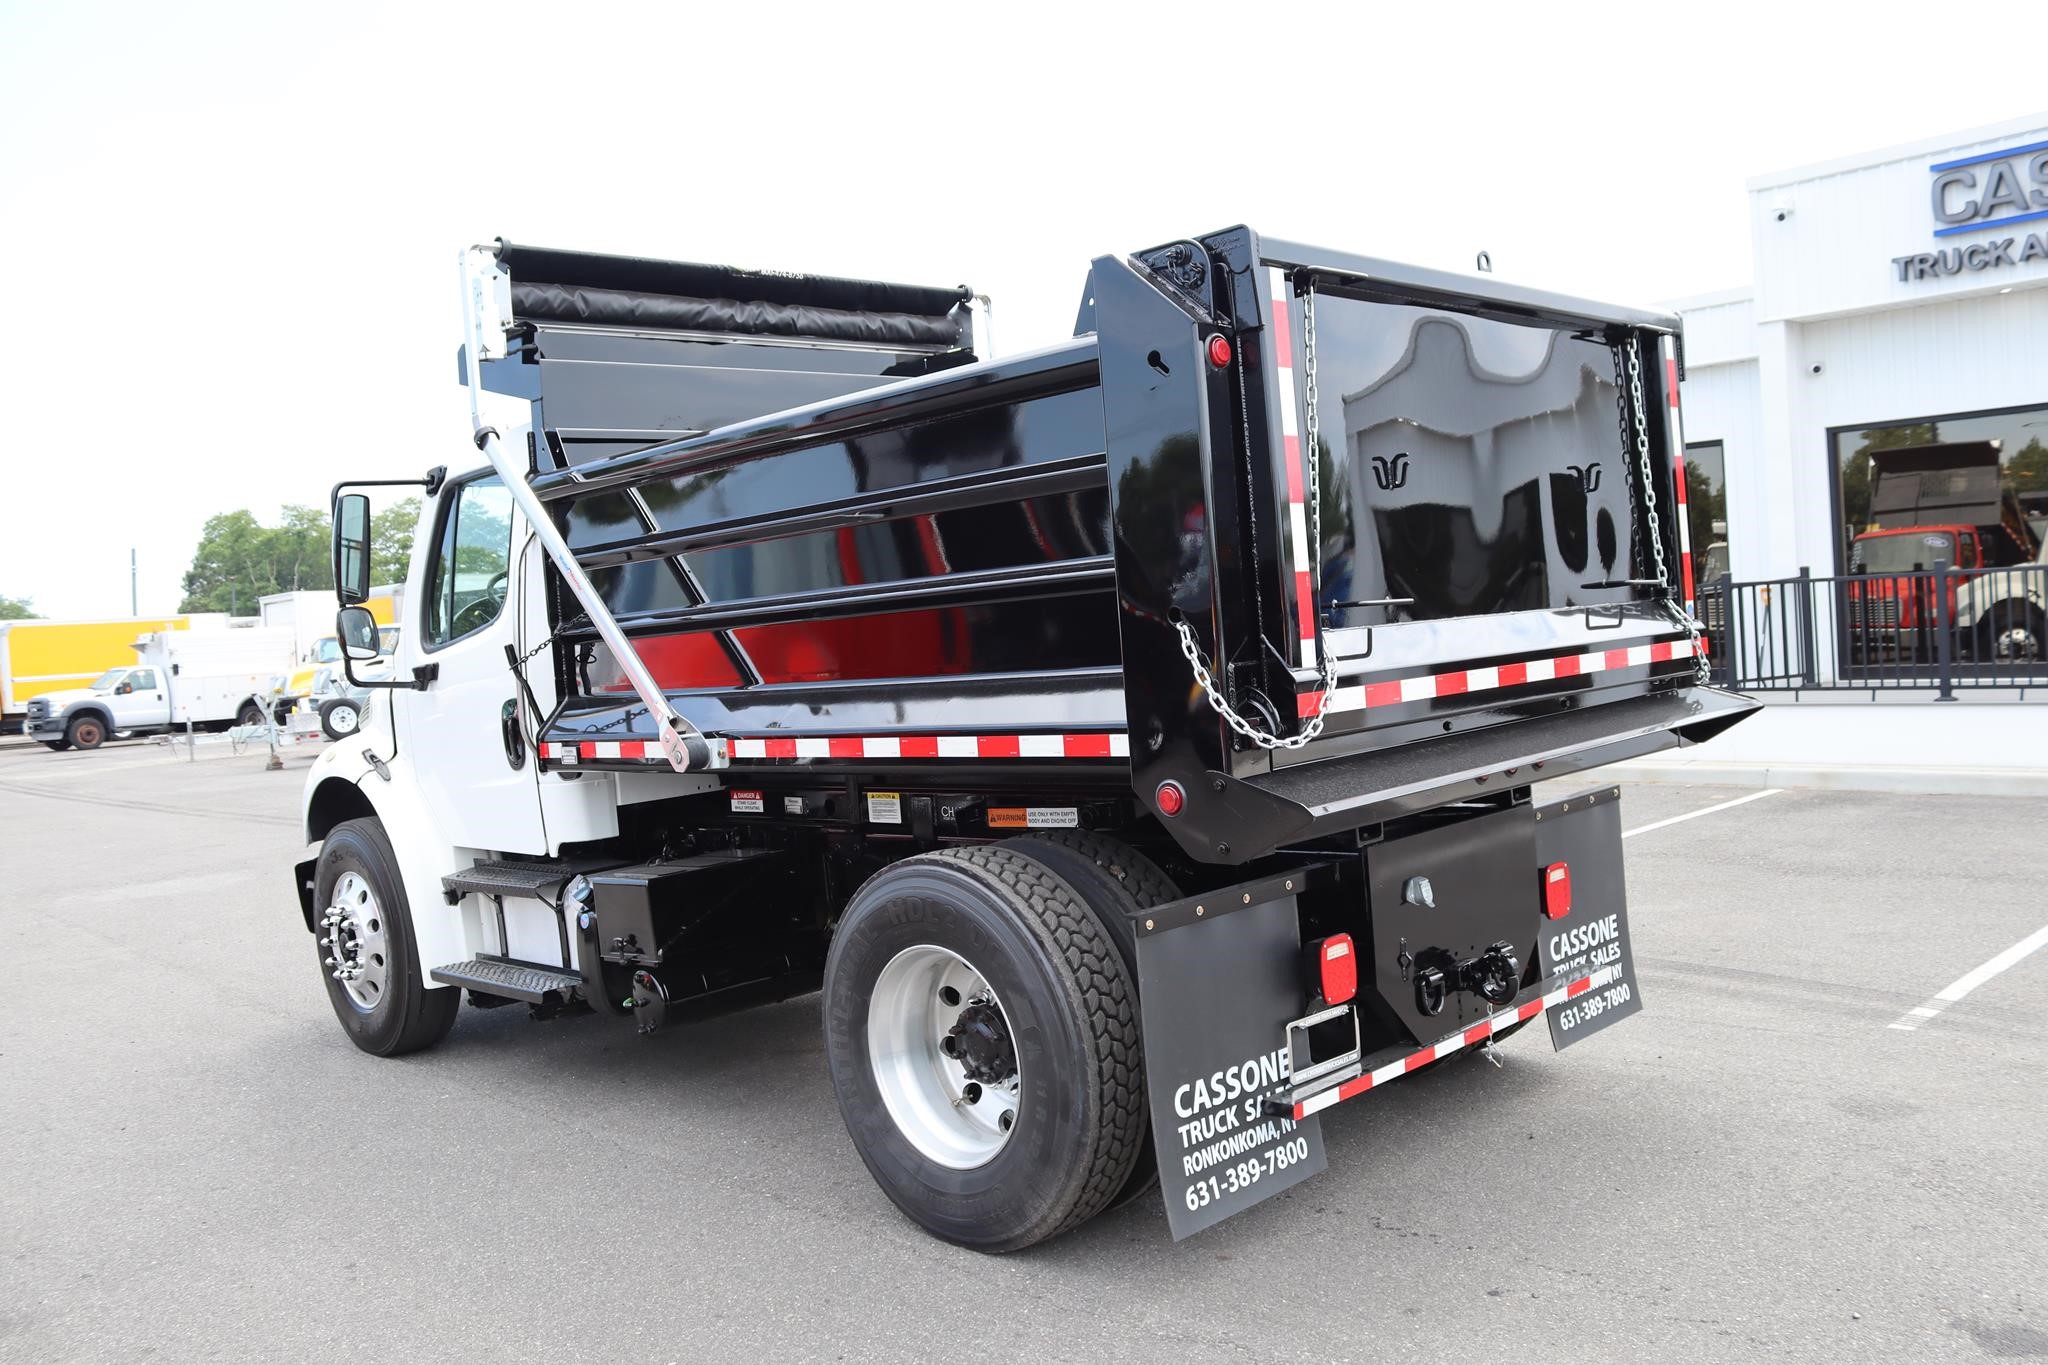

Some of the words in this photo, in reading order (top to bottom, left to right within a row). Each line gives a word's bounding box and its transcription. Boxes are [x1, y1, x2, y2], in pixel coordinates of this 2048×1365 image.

[1891, 237, 2016, 282] TRUCK
[996, 814, 1026, 822] WARNING
[1550, 914, 1619, 962] CASSONE
[1590, 942, 1621, 966] SALES
[1560, 983, 1631, 1031] 631-389-7800
[1174, 1047, 1290, 1119] CASSONE
[1178, 1104, 1240, 1148] TRUCK
[1183, 1123, 1281, 1177] RONKONKOMA,
[1185, 1136, 1309, 1211] 631-389-7800
